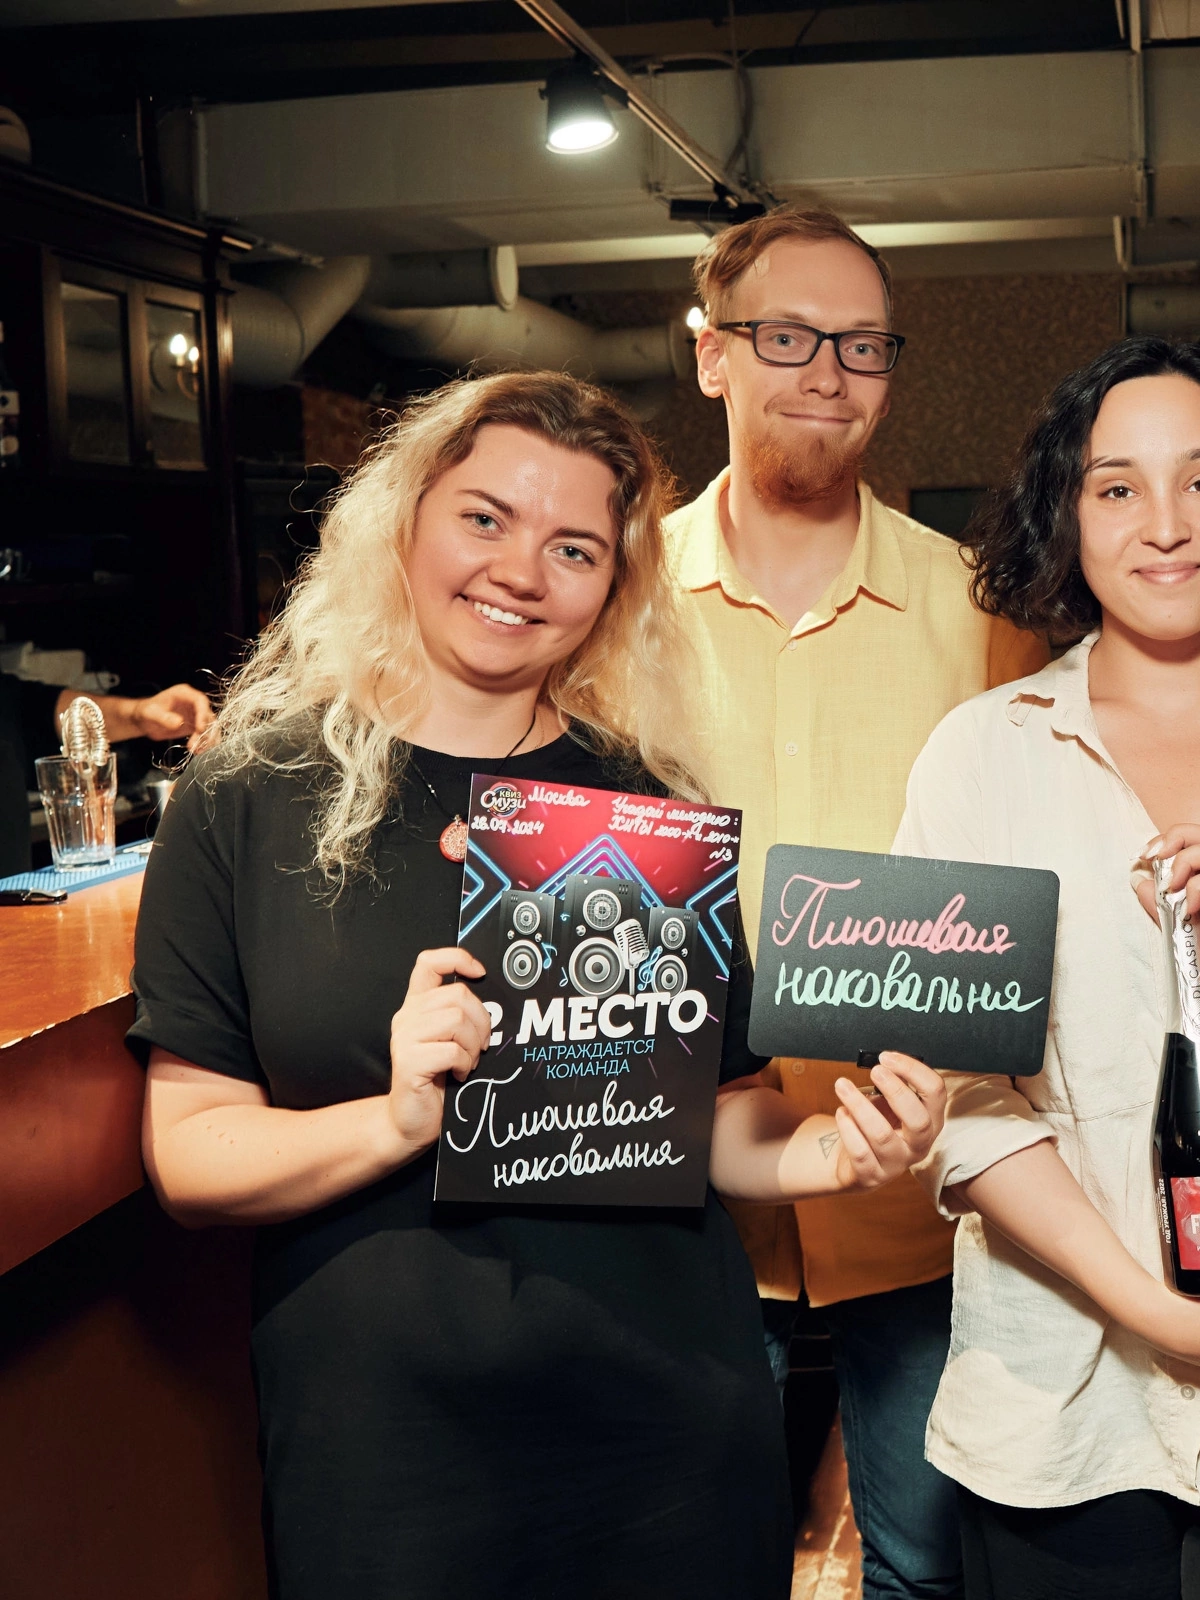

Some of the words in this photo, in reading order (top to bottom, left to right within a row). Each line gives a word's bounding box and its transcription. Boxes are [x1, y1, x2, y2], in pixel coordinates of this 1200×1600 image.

[480, 790, 527, 811] Смузи
[499, 790, 522, 799] КВИЗ
[528, 785, 591, 807] Москва
[772, 873, 1018, 955] Плюшевая
[774, 950, 1045, 1015] наковальня
[515, 989, 708, 1045] МЕСТО
[523, 1038, 656, 1063] НАГРАЖДАЕТСЯ
[546, 1058, 630, 1079] КОМАНДА
[446, 1066, 675, 1154] Плюшевая
[493, 1132, 685, 1189] наковальня
